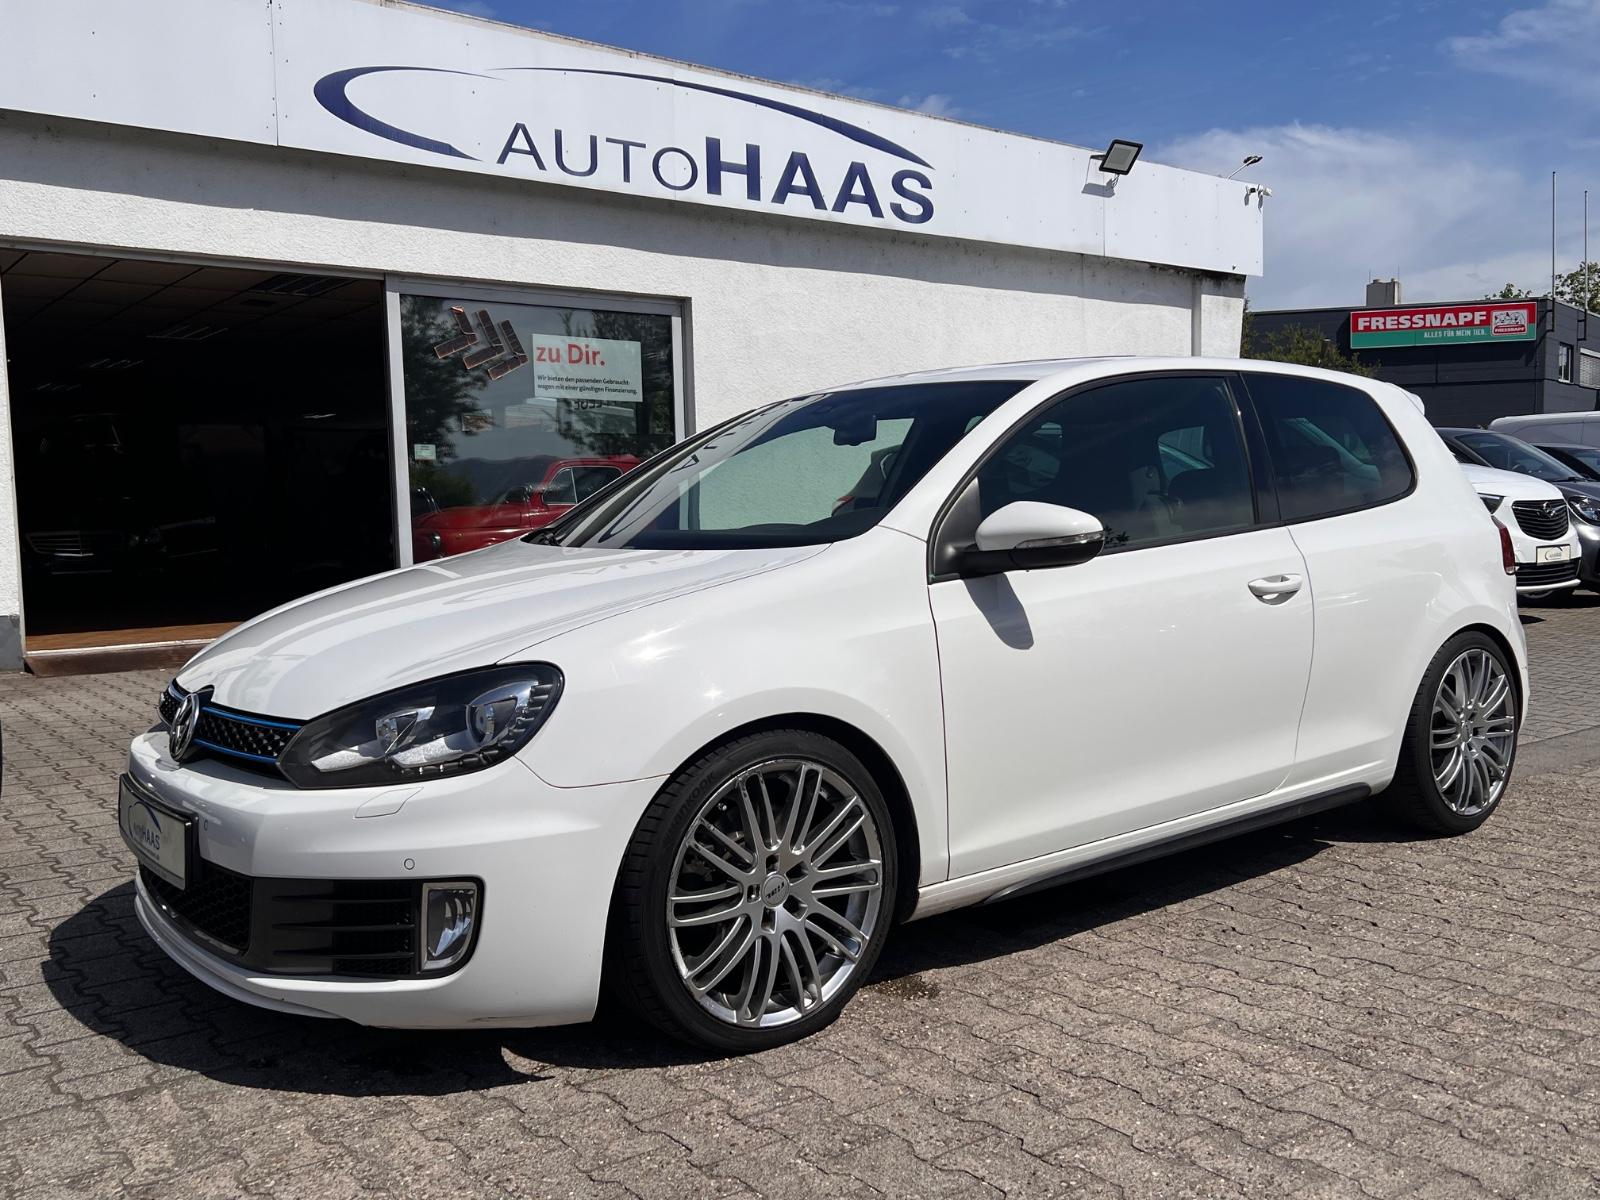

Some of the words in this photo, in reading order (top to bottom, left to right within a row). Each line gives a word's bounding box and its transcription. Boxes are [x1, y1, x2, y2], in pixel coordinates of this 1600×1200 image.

[1357, 311, 1487, 331] FRESSNAPF
[1423, 330, 1443, 338] ALLES
[1443, 329, 1455, 337] FÜR
[1456, 328, 1471, 336] MEIN
[536, 346, 561, 363] zu
[567, 343, 605, 366] Dir.
[579, 385, 604, 393] günstigen
